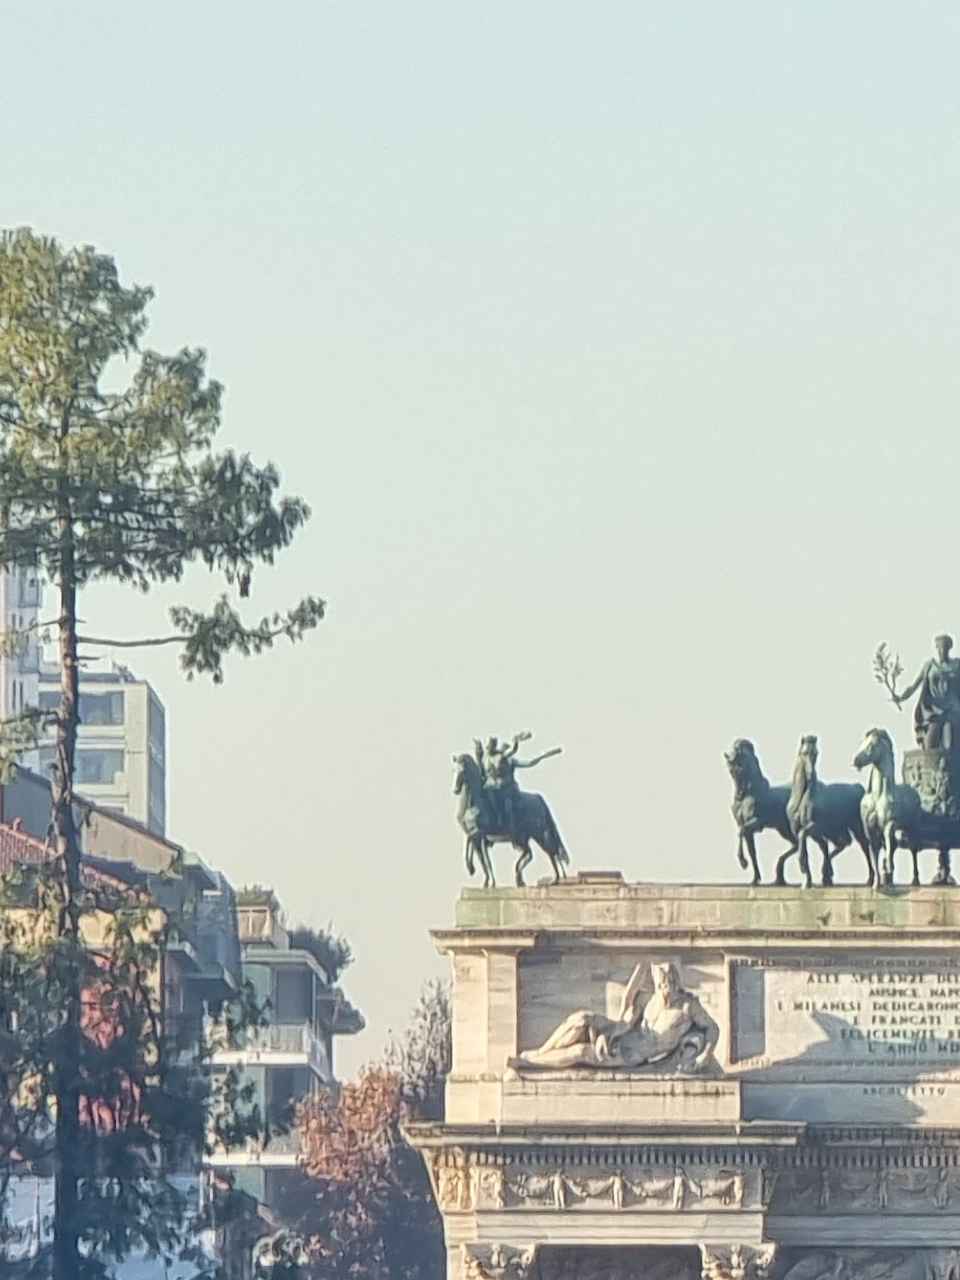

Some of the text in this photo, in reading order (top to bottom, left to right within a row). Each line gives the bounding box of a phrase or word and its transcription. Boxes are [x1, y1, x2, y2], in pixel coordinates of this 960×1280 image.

[937, 972, 959, 984] DEL
[868, 987, 918, 998] AUSPICE
[777, 1000, 783, 1012] I
[793, 1000, 861, 1012] MILANESI
[871, 1015, 941, 1026] FRANCATI
[840, 1028, 935, 1041] FELICEMENTE
